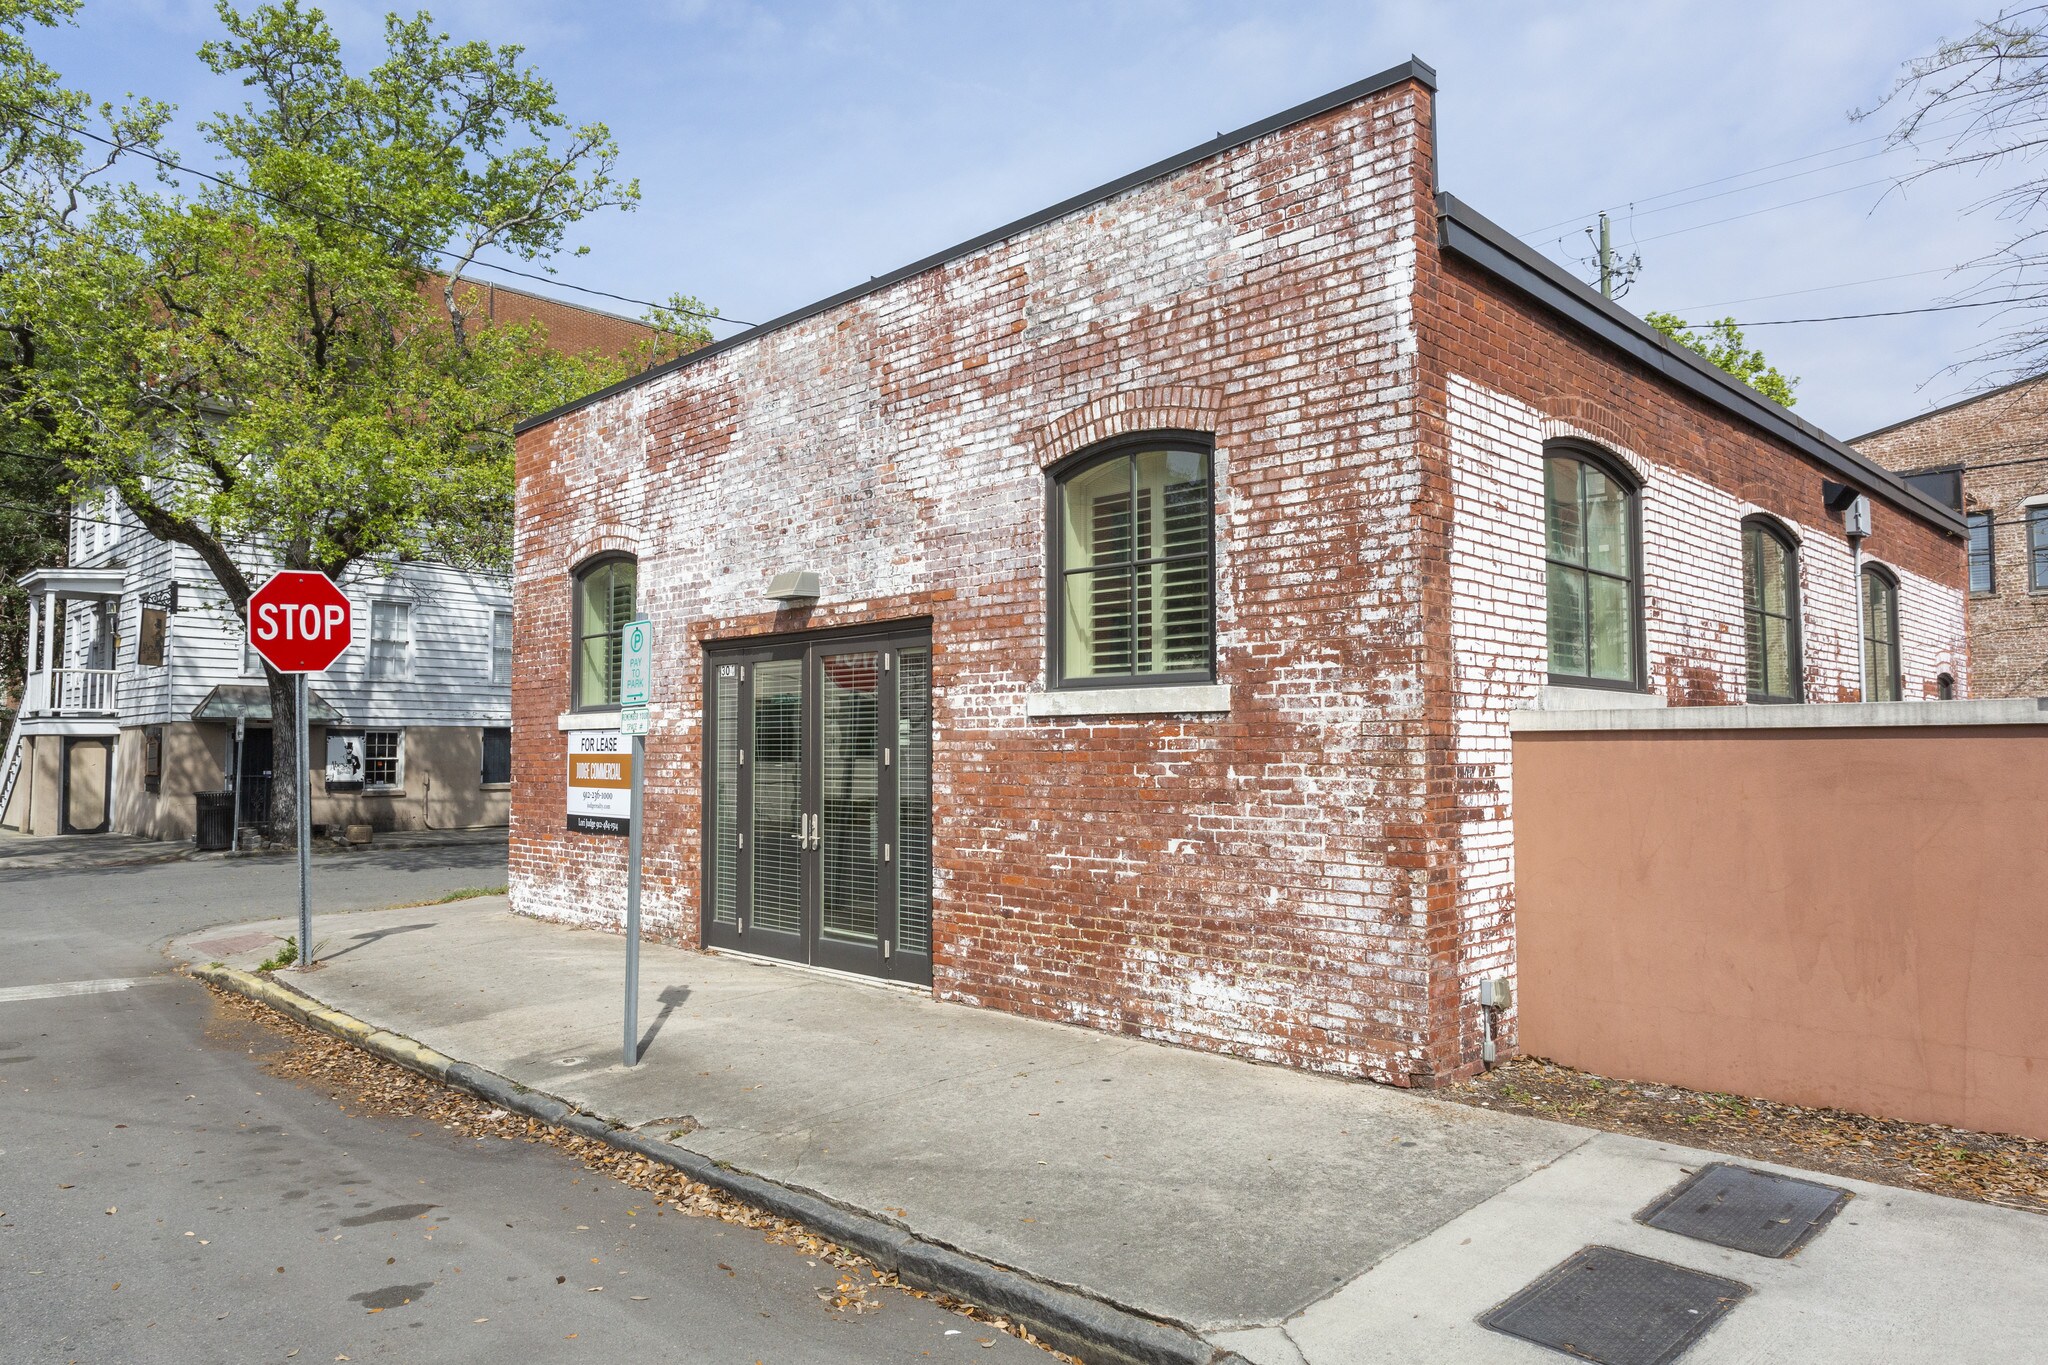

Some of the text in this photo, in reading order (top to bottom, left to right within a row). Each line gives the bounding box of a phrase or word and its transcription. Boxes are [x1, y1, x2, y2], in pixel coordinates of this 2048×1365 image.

[257, 603, 345, 641] STOP
[630, 658, 642, 667] PAY
[632, 669, 640, 678] TO
[722, 665, 734, 676] 30
[627, 678, 644, 688] PARK
[581, 738, 617, 751] FOR LEASE
[576, 762, 621, 780] JUDGE COMMERCIAL
[585, 818, 595, 829] Judge
